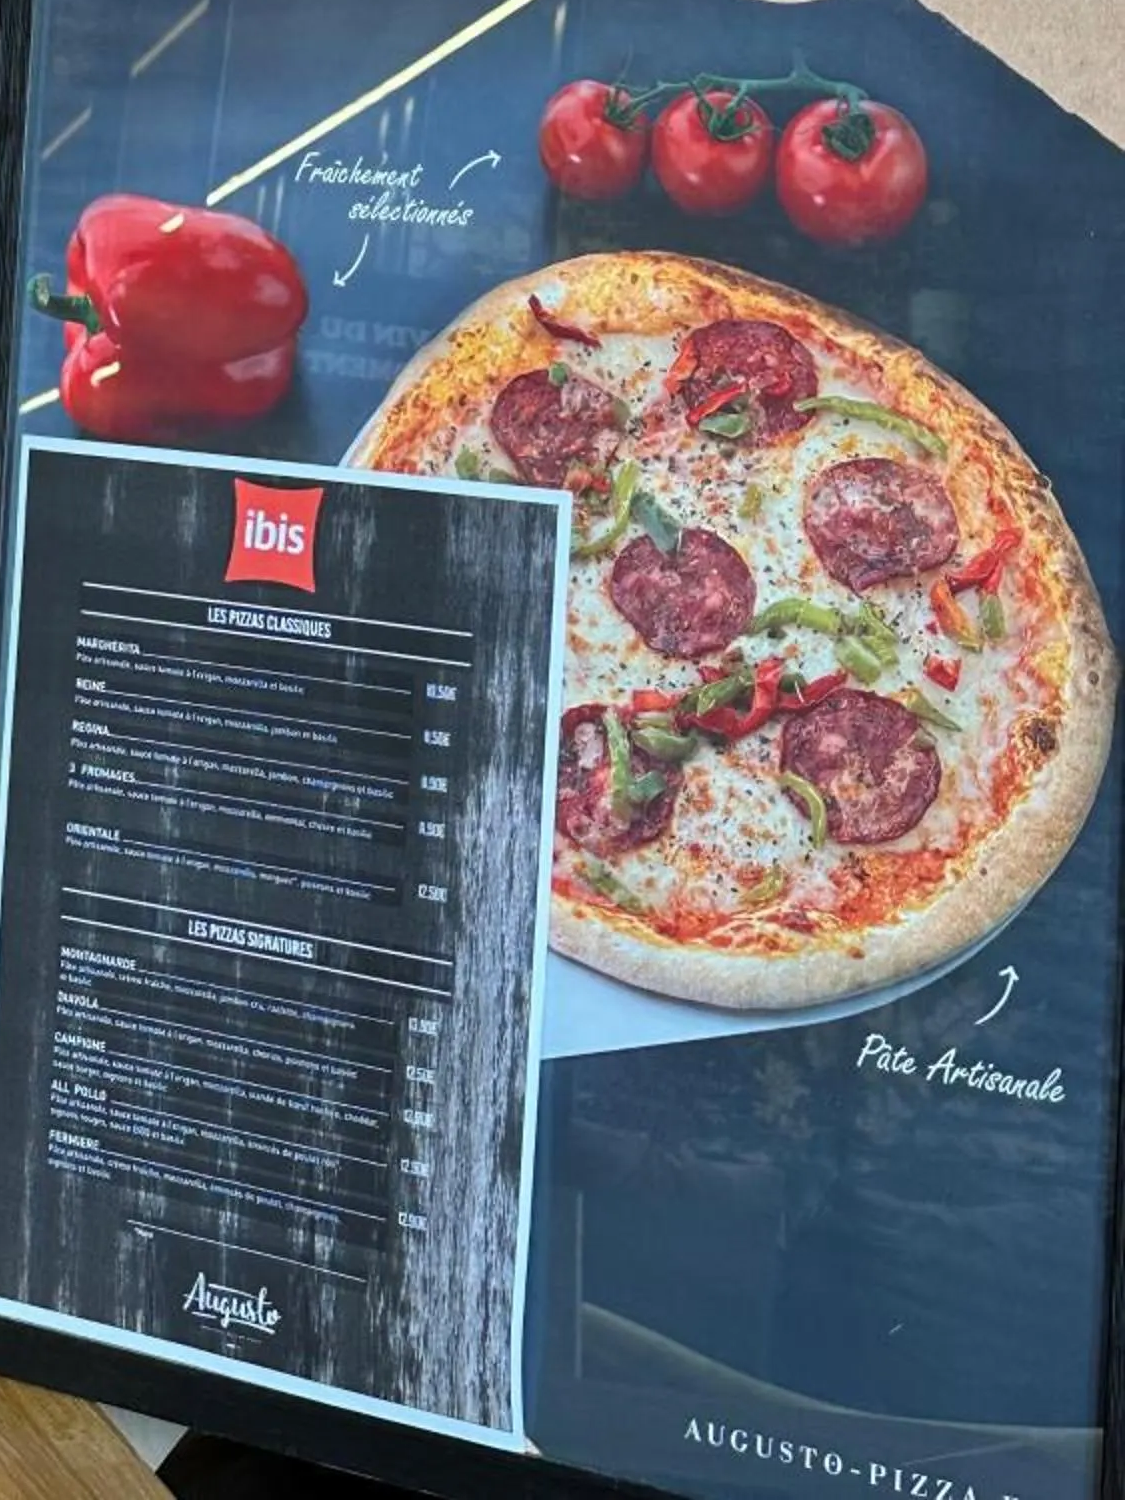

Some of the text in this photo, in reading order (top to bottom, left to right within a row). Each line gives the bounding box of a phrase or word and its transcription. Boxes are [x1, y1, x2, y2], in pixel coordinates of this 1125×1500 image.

[295, 152, 423, 187] Fraîchement
[348, 191, 474, 225] sélectionnés
[244, 508, 305, 555] ibis
[207, 606, 331, 638] LES PIZZAS CLASSIQUES
[76, 635, 140, 655] MARGHERITA
[75, 677, 105, 692] REINE
[66, 821, 120, 841] ORIENTALE
[188, 919, 313, 959] LES PIZZAS SIGNATURES
[857, 1033, 1067, 1103] Pâte Artisanale
[74, 1083, 106, 1102] POLLO
[183, 1272, 282, 1334] Augusto
[683, 1417, 1021, 1500] AUGUSTO-PIZZA
